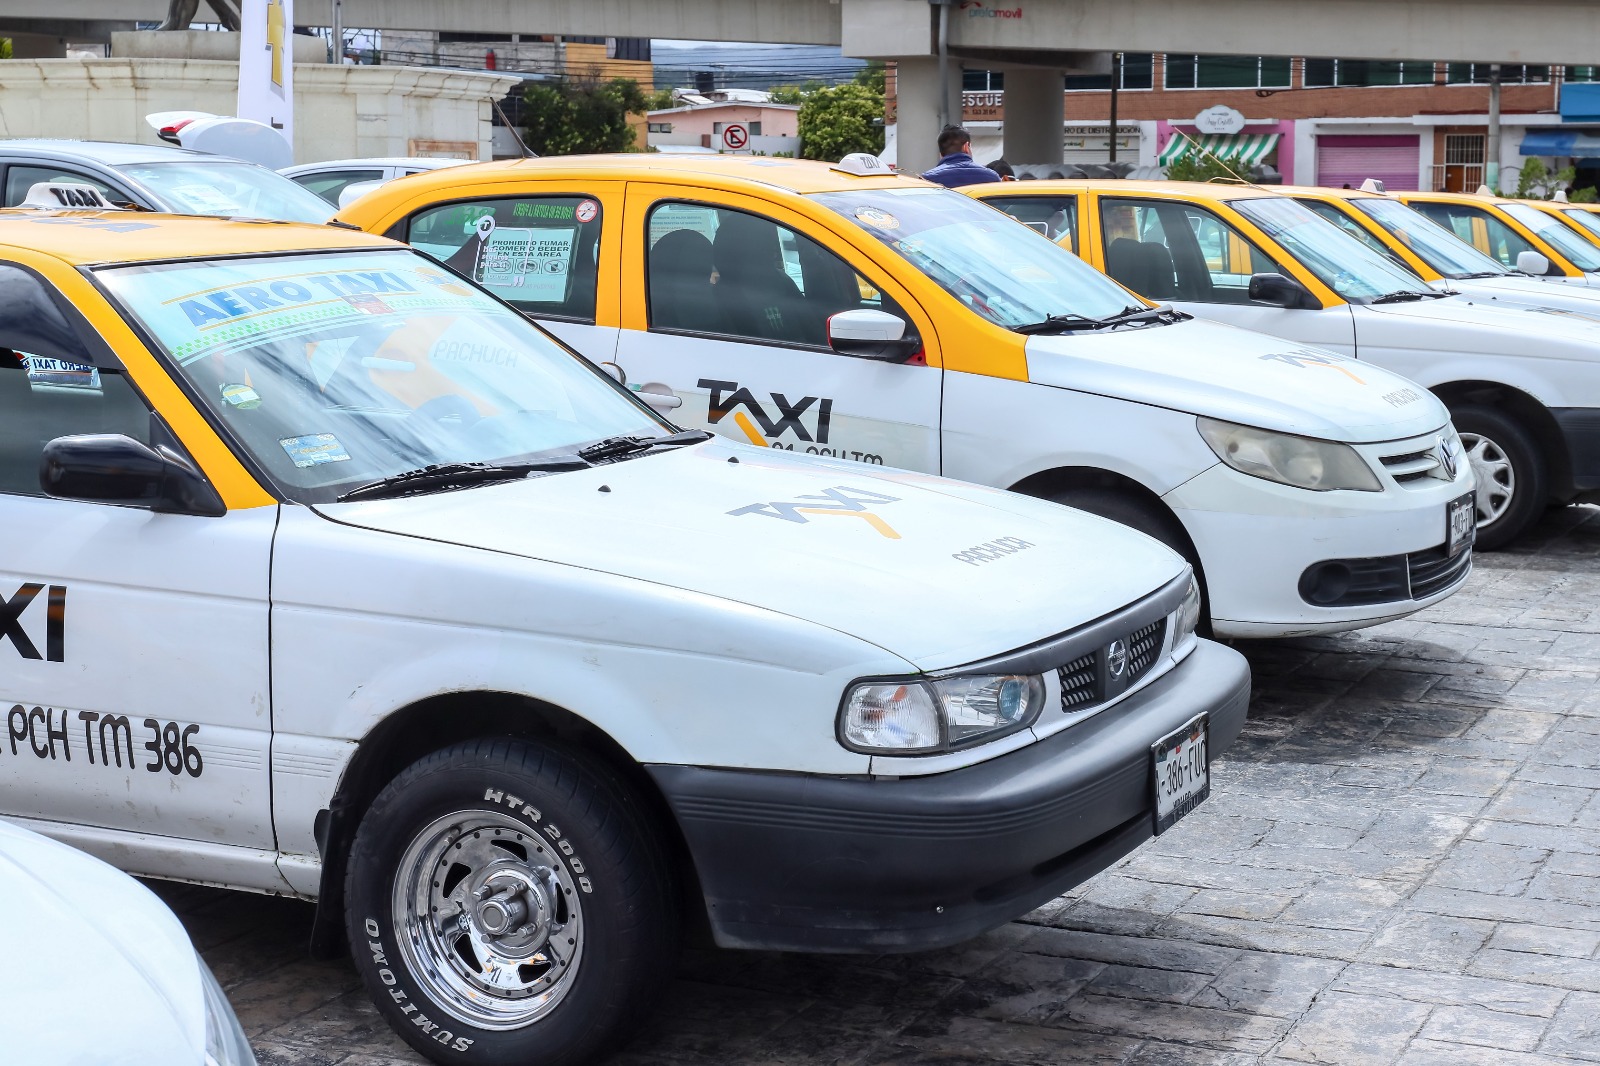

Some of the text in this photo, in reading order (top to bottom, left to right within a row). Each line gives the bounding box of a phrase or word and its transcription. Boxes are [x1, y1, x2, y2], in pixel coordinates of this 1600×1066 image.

[730, 129, 741, 144] E
[860, 156, 881, 169] TAXI
[50, 187, 104, 207] TAXI
[178, 279, 312, 327] AERO
[311, 271, 417, 298] TAXI
[433, 339, 519, 368] PACHUCA
[696, 378, 833, 447] TAXI
[725, 486, 903, 539] TAXI
[951, 536, 1037, 567] PACHUCA
[8, 704, 71, 762] PCH
[143, 718, 204, 778] 386
[484, 788, 593, 894] HTR 2000
[365, 917, 475, 1052] SUMITOMO
